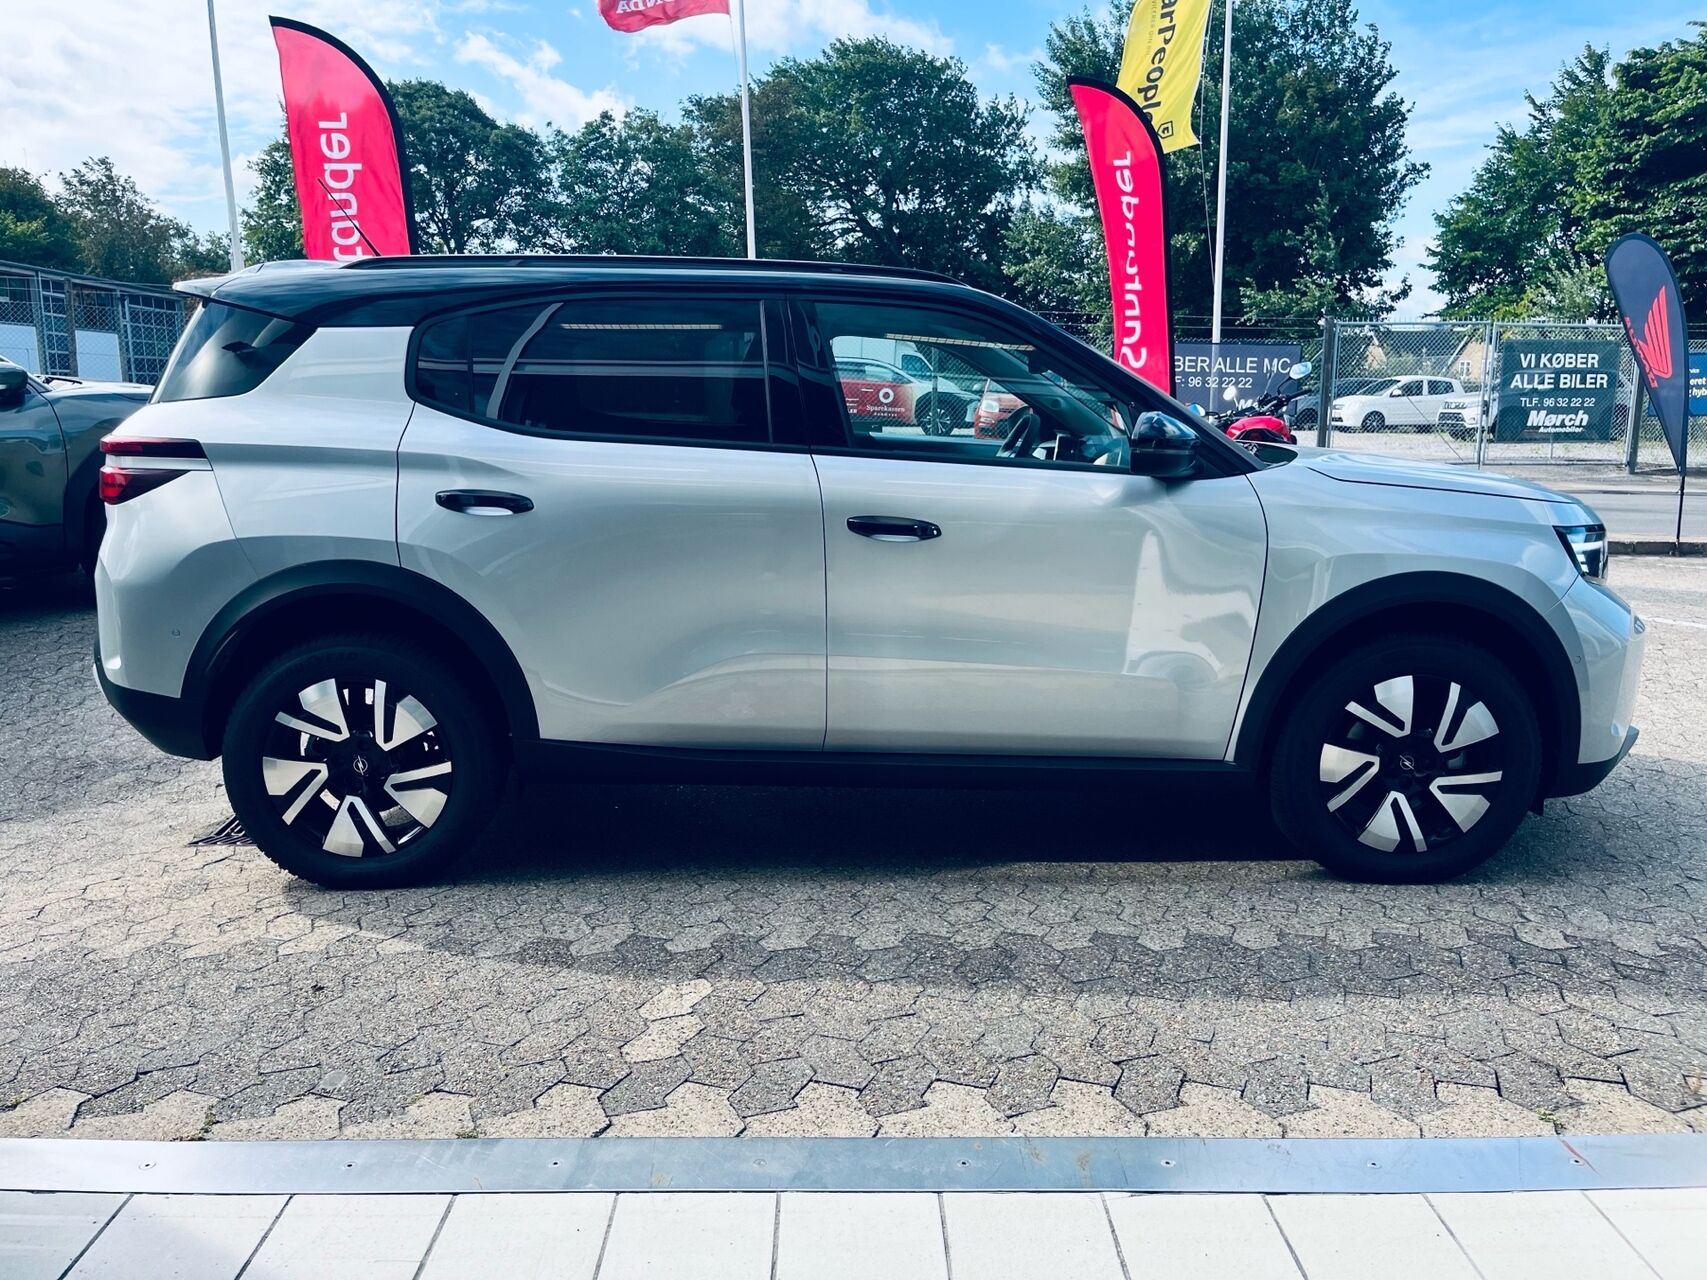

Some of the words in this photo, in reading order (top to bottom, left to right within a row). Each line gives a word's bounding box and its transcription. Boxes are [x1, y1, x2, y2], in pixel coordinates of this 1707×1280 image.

[1213, 357, 1258, 373] ALLE
[1263, 358, 1291, 373] MC
[1520, 353, 1535, 368] VI
[1540, 353, 1599, 368] KØBER
[1188, 377, 1202, 387] 96
[1205, 377, 1218, 387] 32
[1222, 377, 1236, 388] 22
[1238, 378, 1253, 388] 22
[1510, 374, 1555, 389] ALLE
[1560, 374, 1608, 388] BILER
[1520, 398, 1540, 407] TLF.
[1543, 398, 1554, 407] 96
[1556, 398, 1568, 407] 32
[1570, 398, 1582, 407] 22
[1584, 398, 1596, 407] 22
[1527, 410, 1589, 427] Mørch
